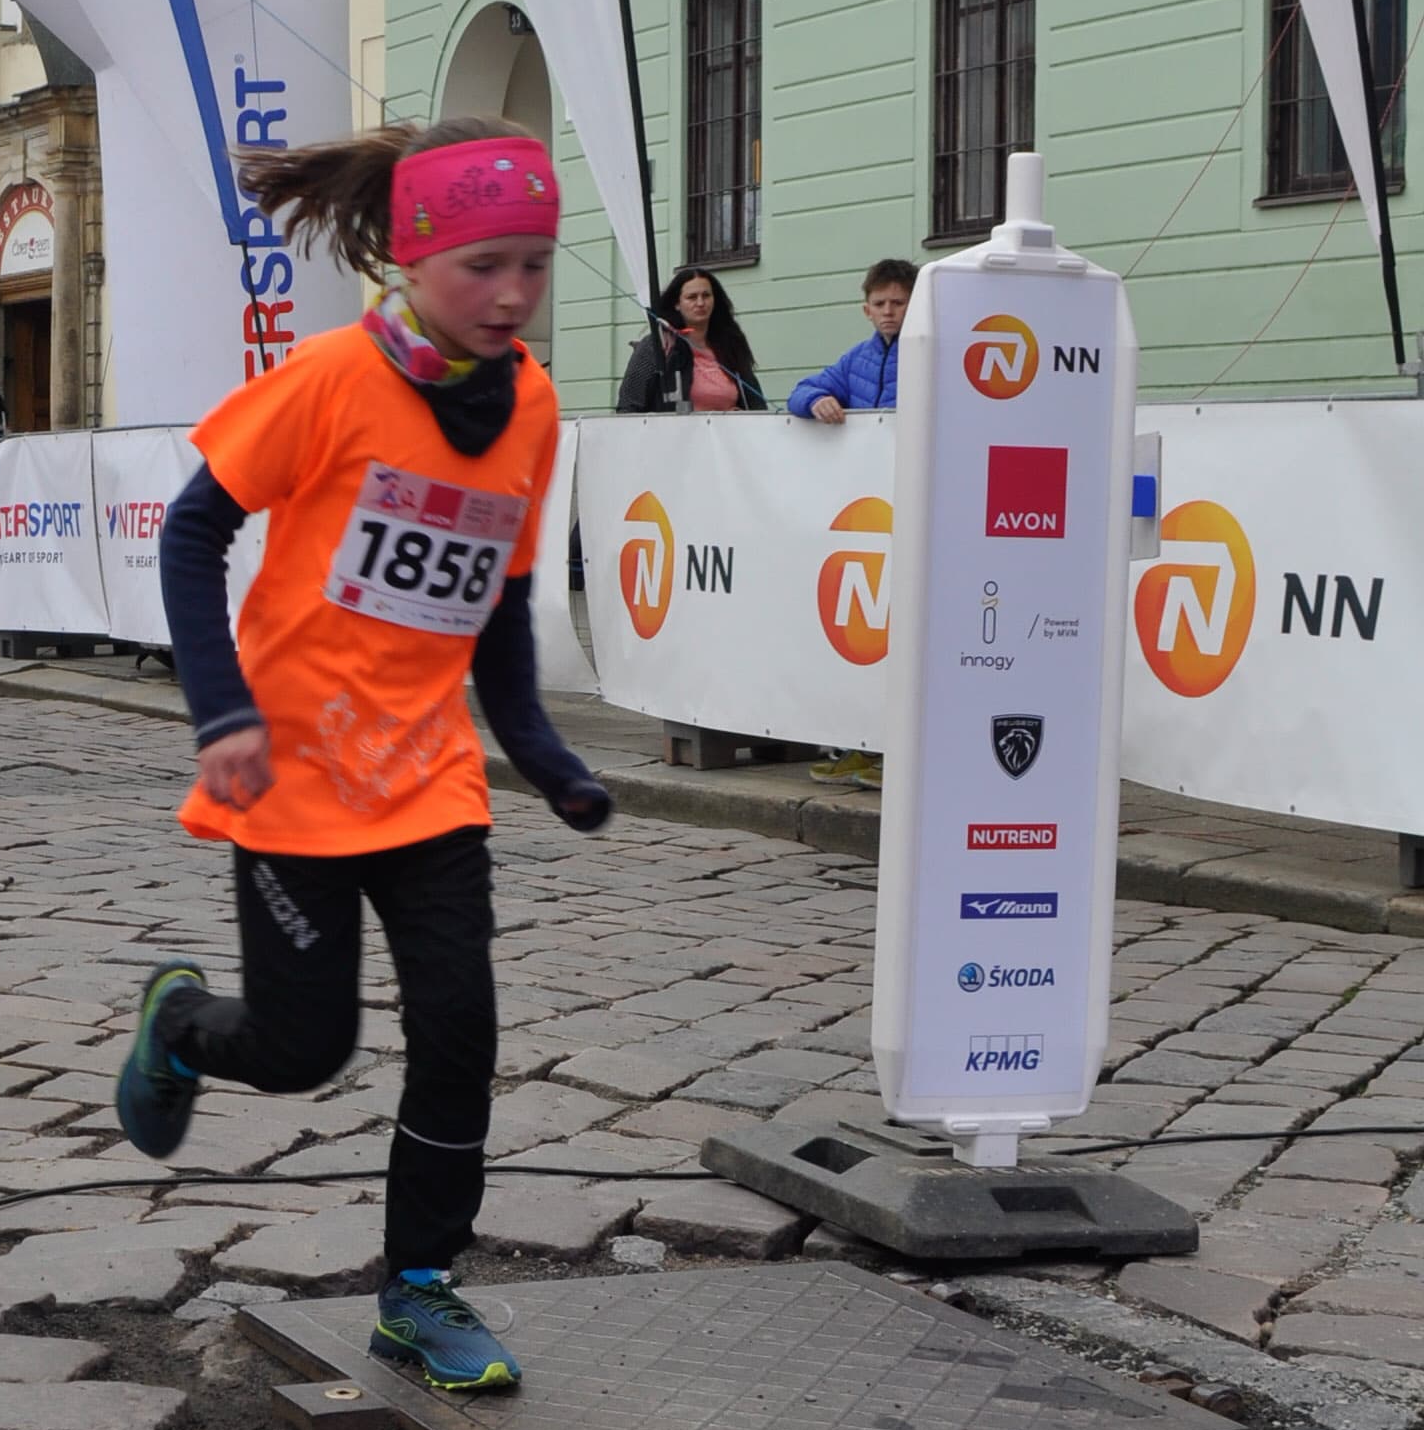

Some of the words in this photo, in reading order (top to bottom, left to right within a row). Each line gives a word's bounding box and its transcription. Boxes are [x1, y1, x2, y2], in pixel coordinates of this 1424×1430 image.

[1053, 344, 1101, 374] NN
[993, 512, 1058, 531] AVON
[359, 520, 498, 604] 1858
[685, 544, 735, 595] NN
[1281, 571, 1385, 641] NN
[959, 651, 1016, 671] innogy
[972, 829, 1054, 845] NUTREND
[987, 965, 1055, 988] ŠKODA
[965, 1048, 1041, 1072] KPMG
